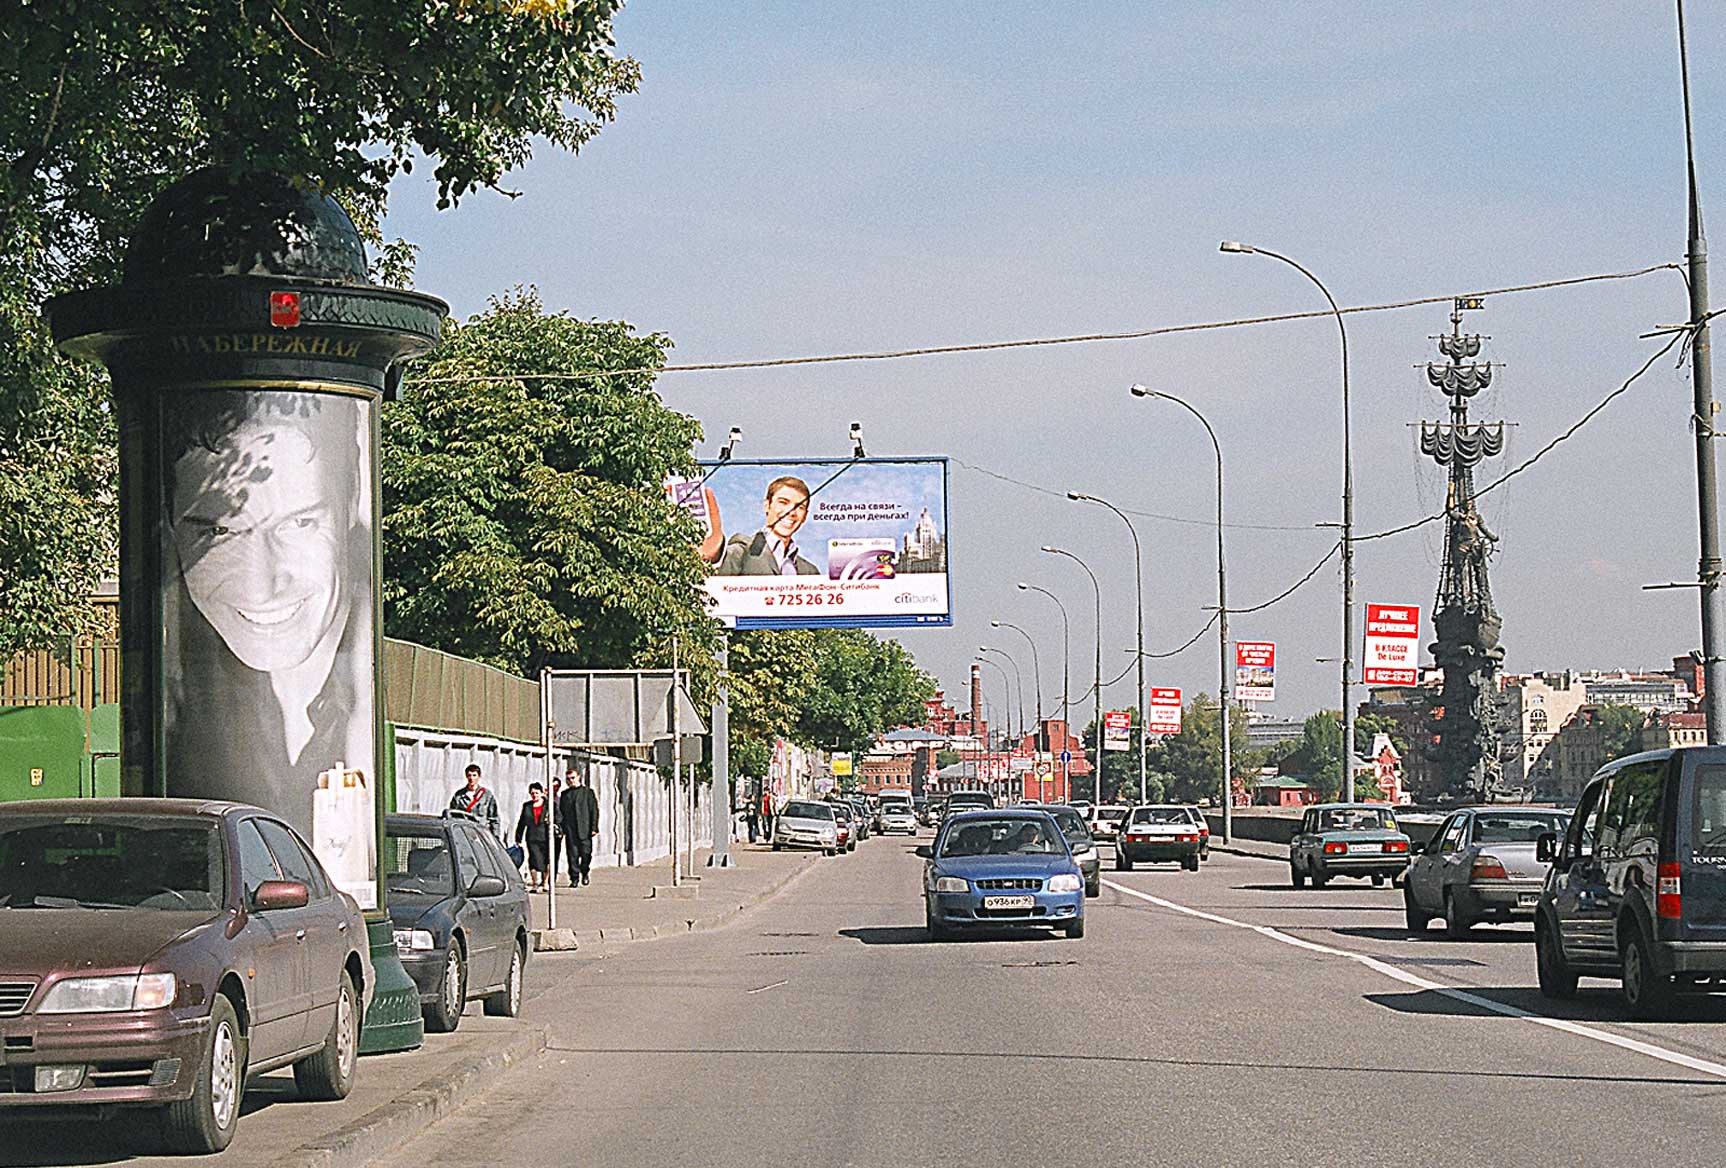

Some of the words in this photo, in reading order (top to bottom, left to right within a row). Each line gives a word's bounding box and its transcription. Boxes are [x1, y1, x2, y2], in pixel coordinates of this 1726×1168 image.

[169, 334, 362, 359] НАБЕРЕЖНАЯ
[819, 502, 853, 512] Всегда
[854, 503, 866, 511] на
[868, 503, 895, 511] связи
[813, 513, 846, 521] всегда
[847, 513, 866, 522] при
[867, 511, 909, 521] деньгах!
[723, 585, 769, 593] Кредитная
[770, 585, 794, 593] карта
[778, 594, 803, 605] 725
[806, 593, 823, 605] 26
[827, 593, 844, 605] 26
[894, 592, 938, 604] citibank
